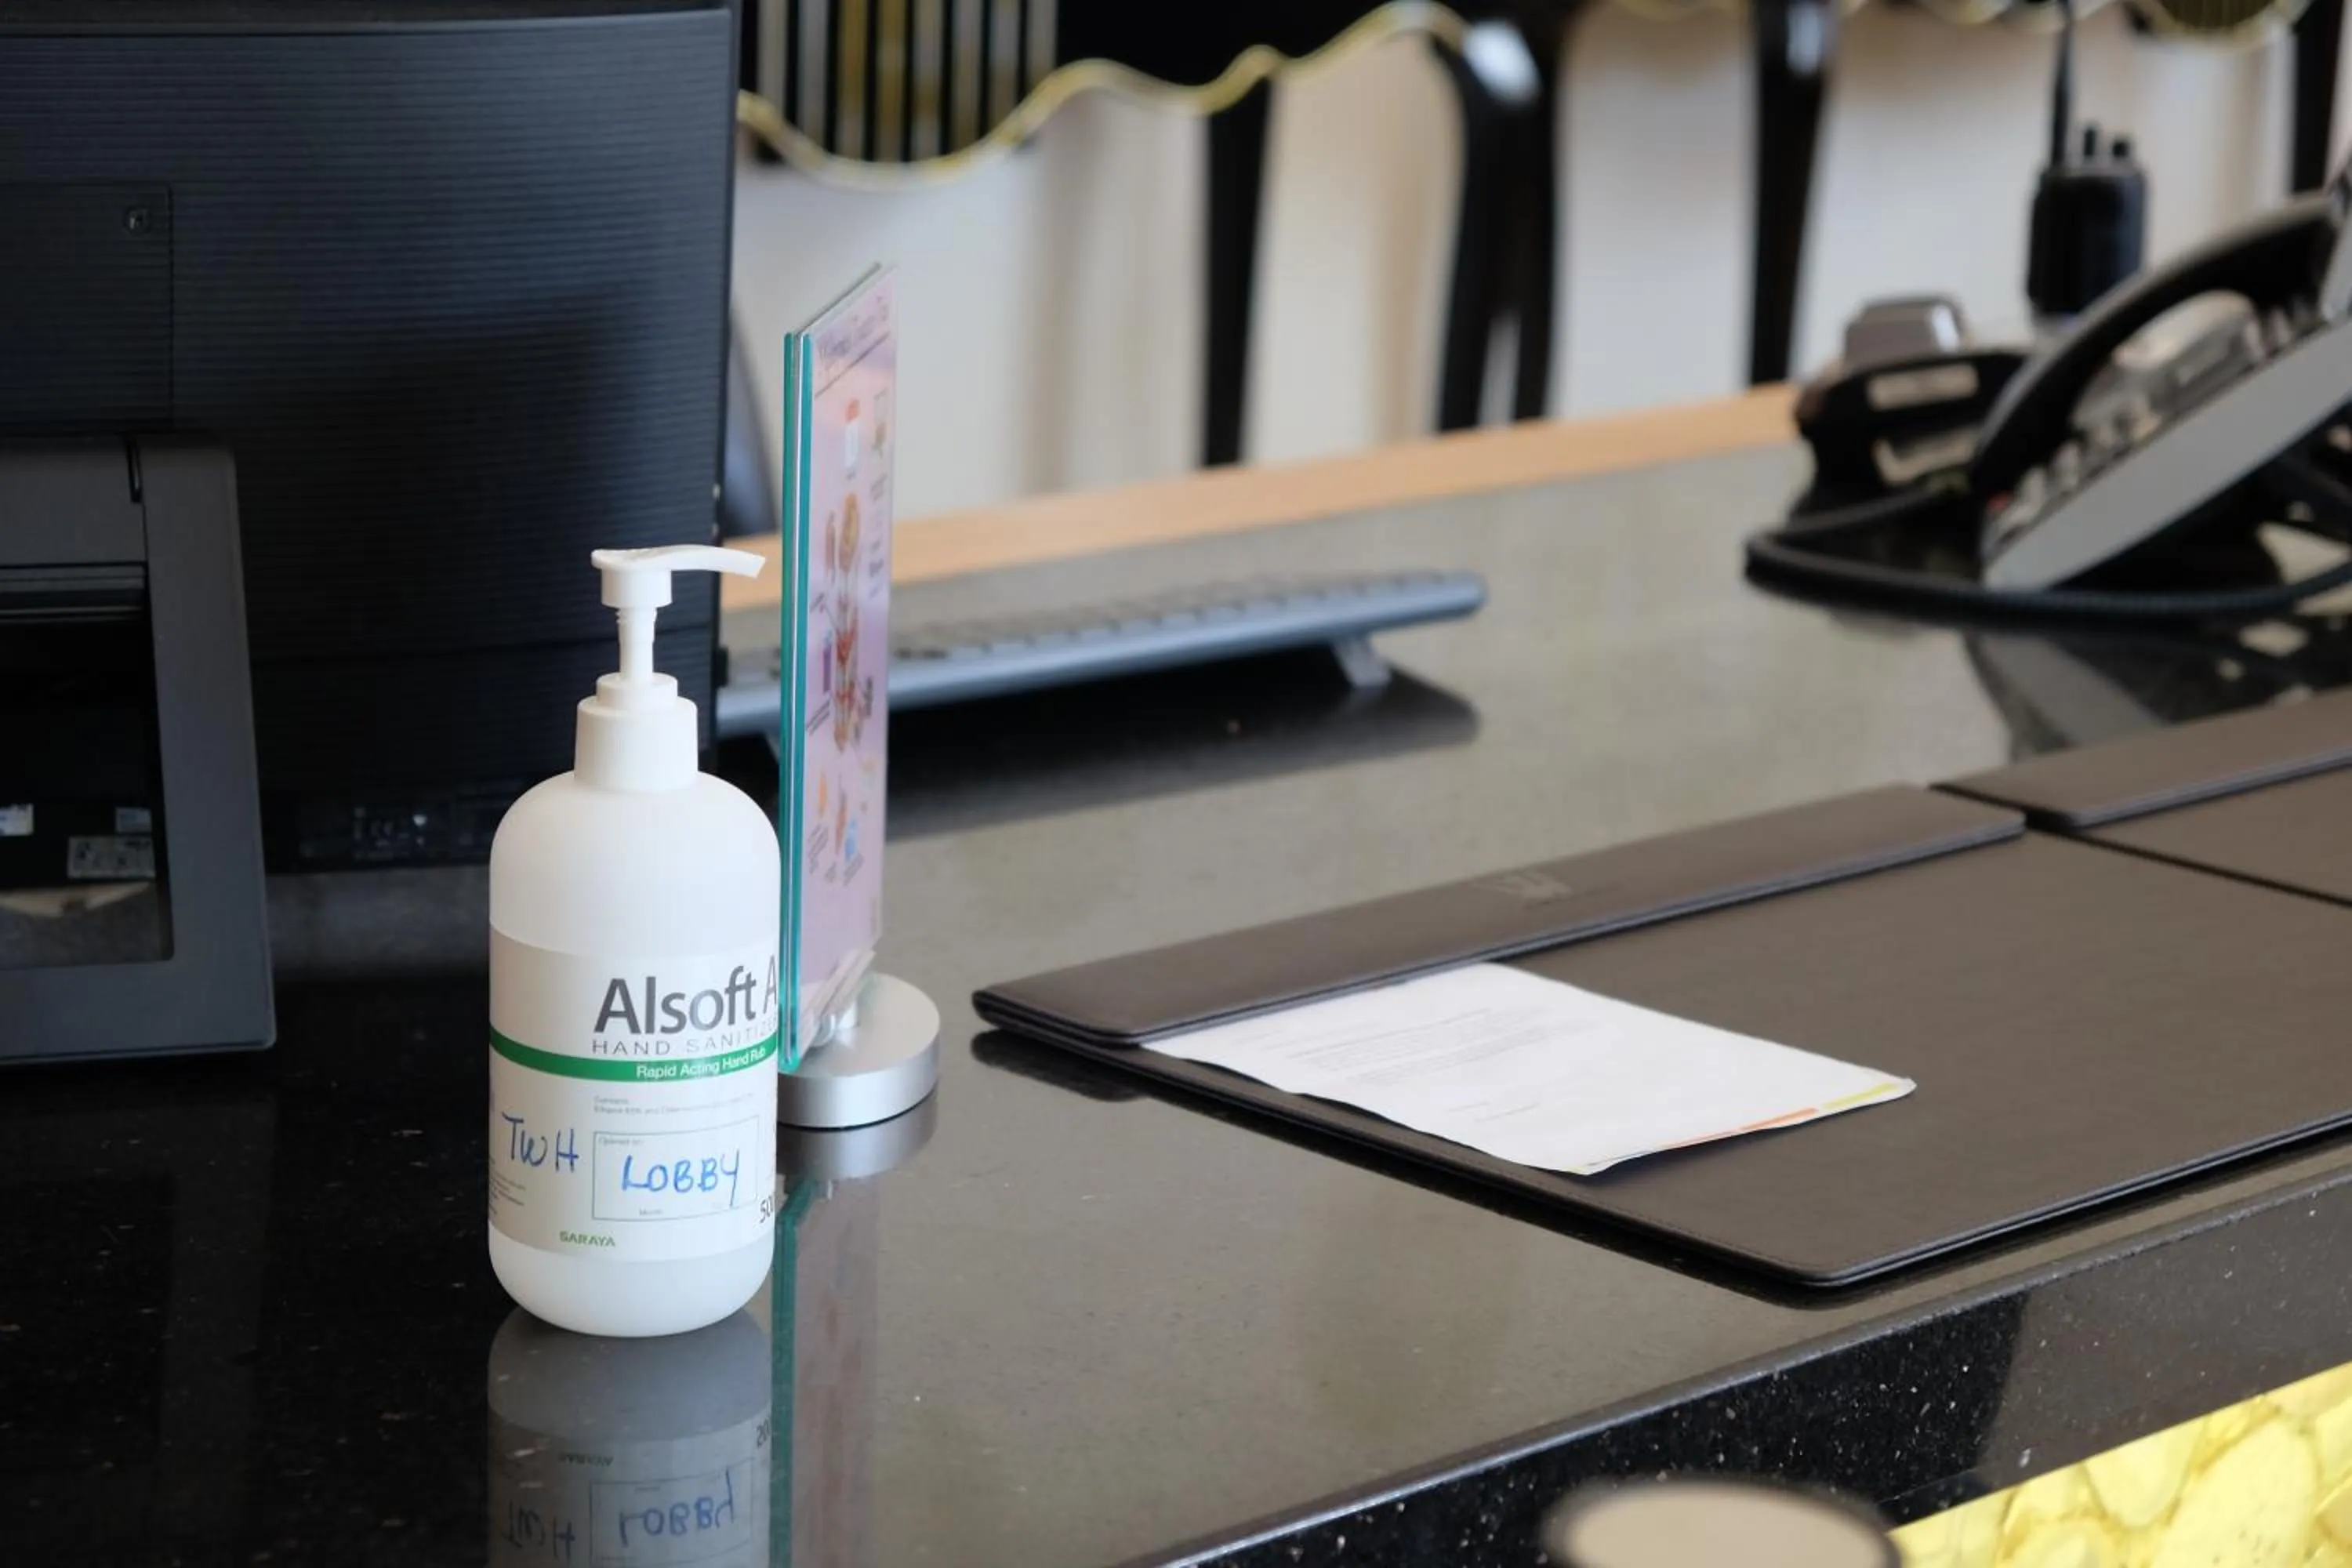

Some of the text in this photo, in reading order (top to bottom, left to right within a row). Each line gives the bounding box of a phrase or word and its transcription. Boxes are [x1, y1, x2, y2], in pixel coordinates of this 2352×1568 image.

[593, 964, 757, 1035] Alsoft
[592, 1040, 671, 1055] HAND
[636, 1047, 767, 1080] Rapid Acting Hand Rub
[621, 1148, 740, 1209] LOBBY
[559, 1231, 616, 1249] SARAYA
